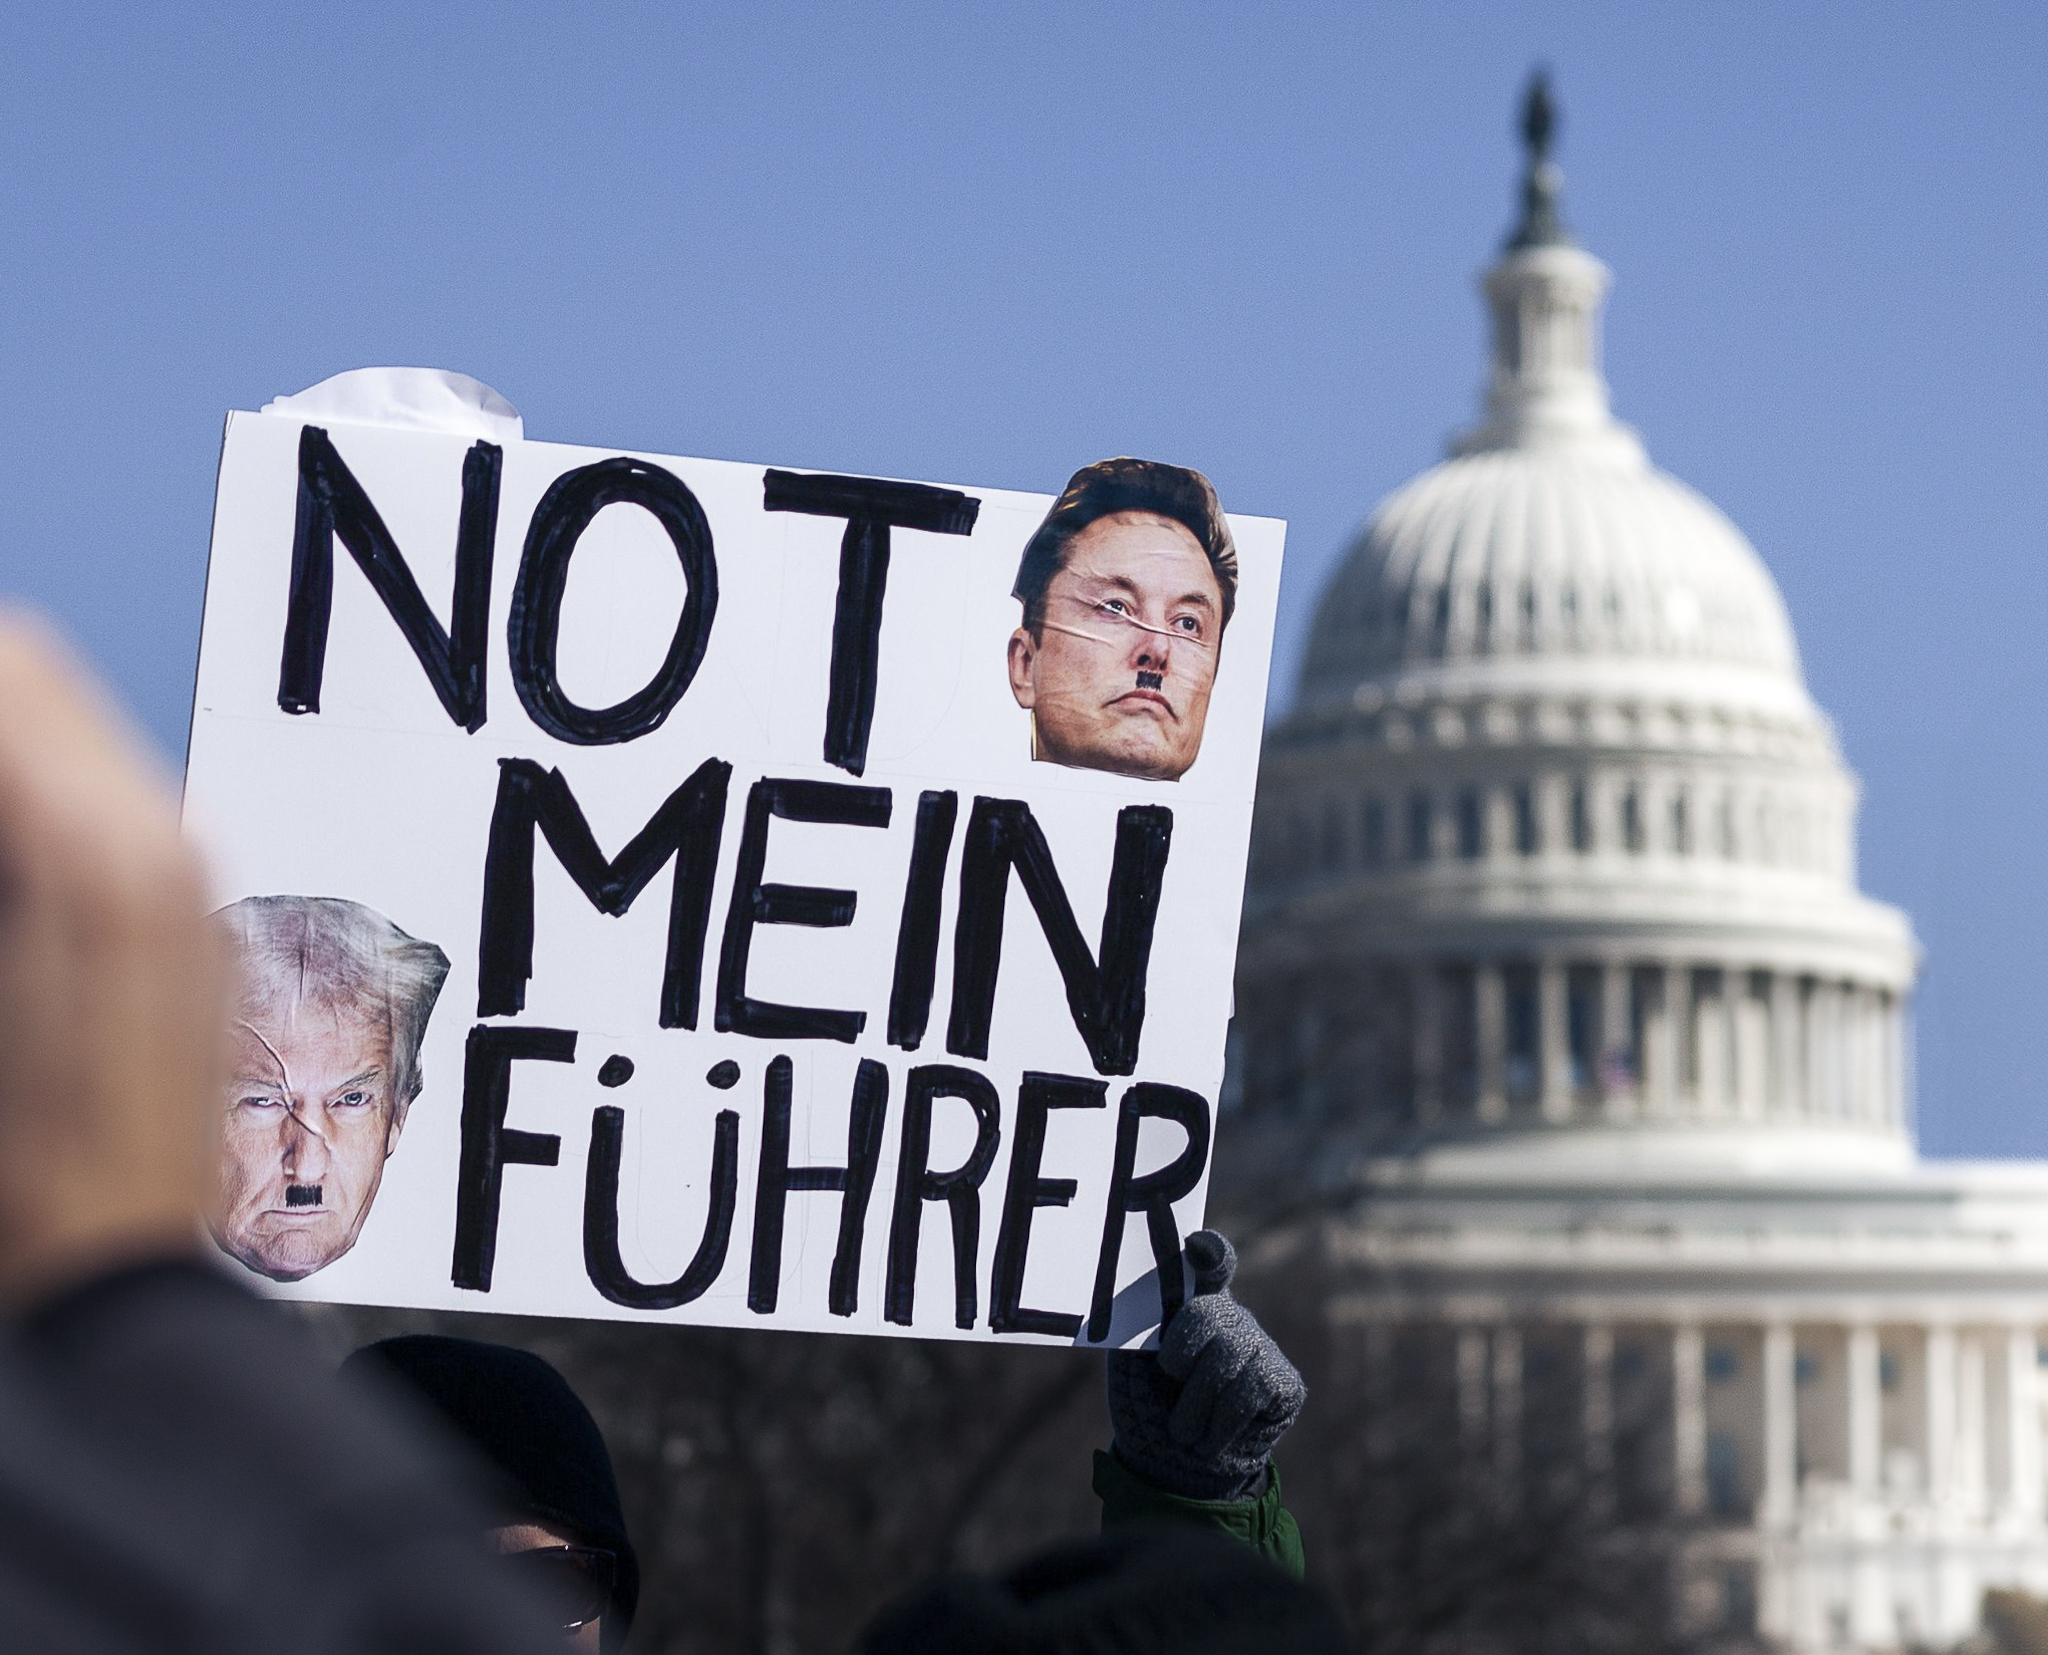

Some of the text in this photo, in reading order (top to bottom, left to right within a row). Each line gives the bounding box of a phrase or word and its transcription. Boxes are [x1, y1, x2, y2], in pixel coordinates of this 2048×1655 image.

[277, 424, 981, 777] NOT
[477, 756, 1174, 1076] MEIN
[451, 1024, 1209, 1343] FÜHRER
